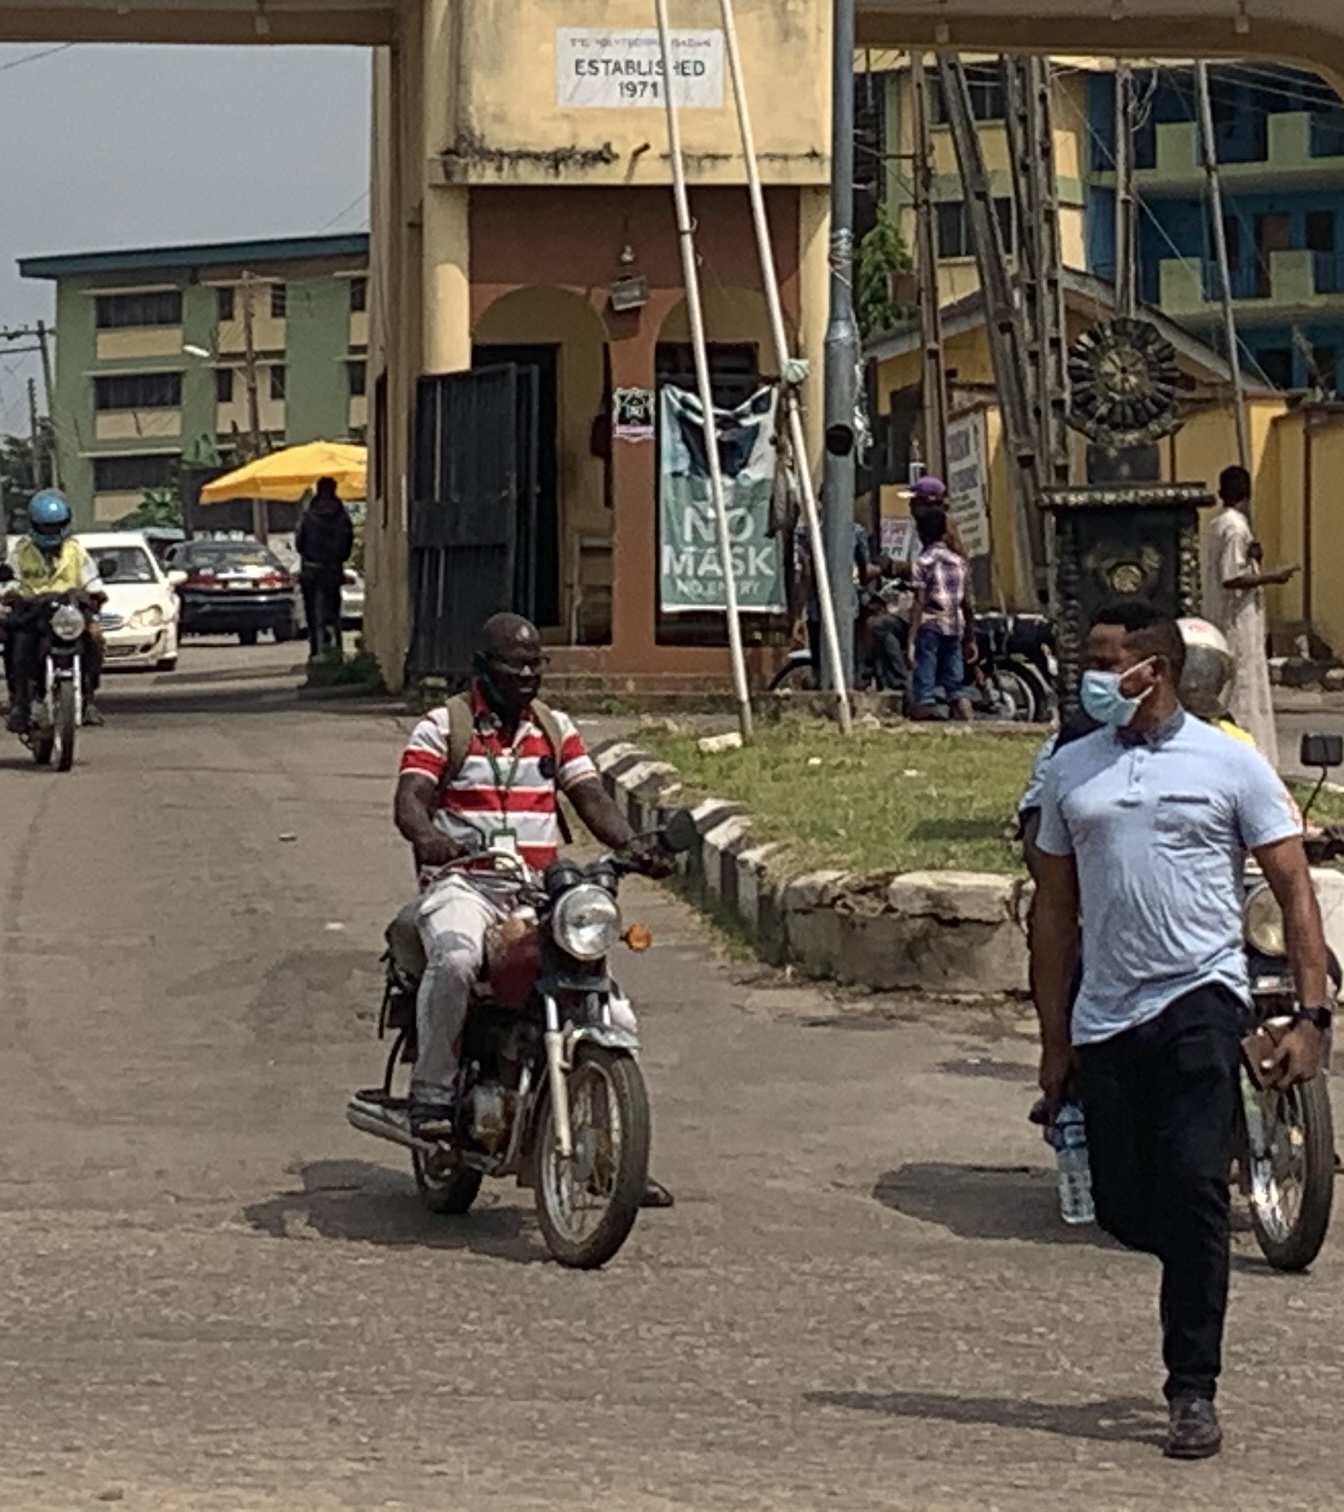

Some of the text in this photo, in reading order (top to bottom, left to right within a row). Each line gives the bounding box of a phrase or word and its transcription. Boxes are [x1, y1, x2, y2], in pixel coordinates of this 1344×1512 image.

[618, 80, 659, 99] 1971
[683, 506, 755, 542] NO
[662, 544, 775, 577] MASK
